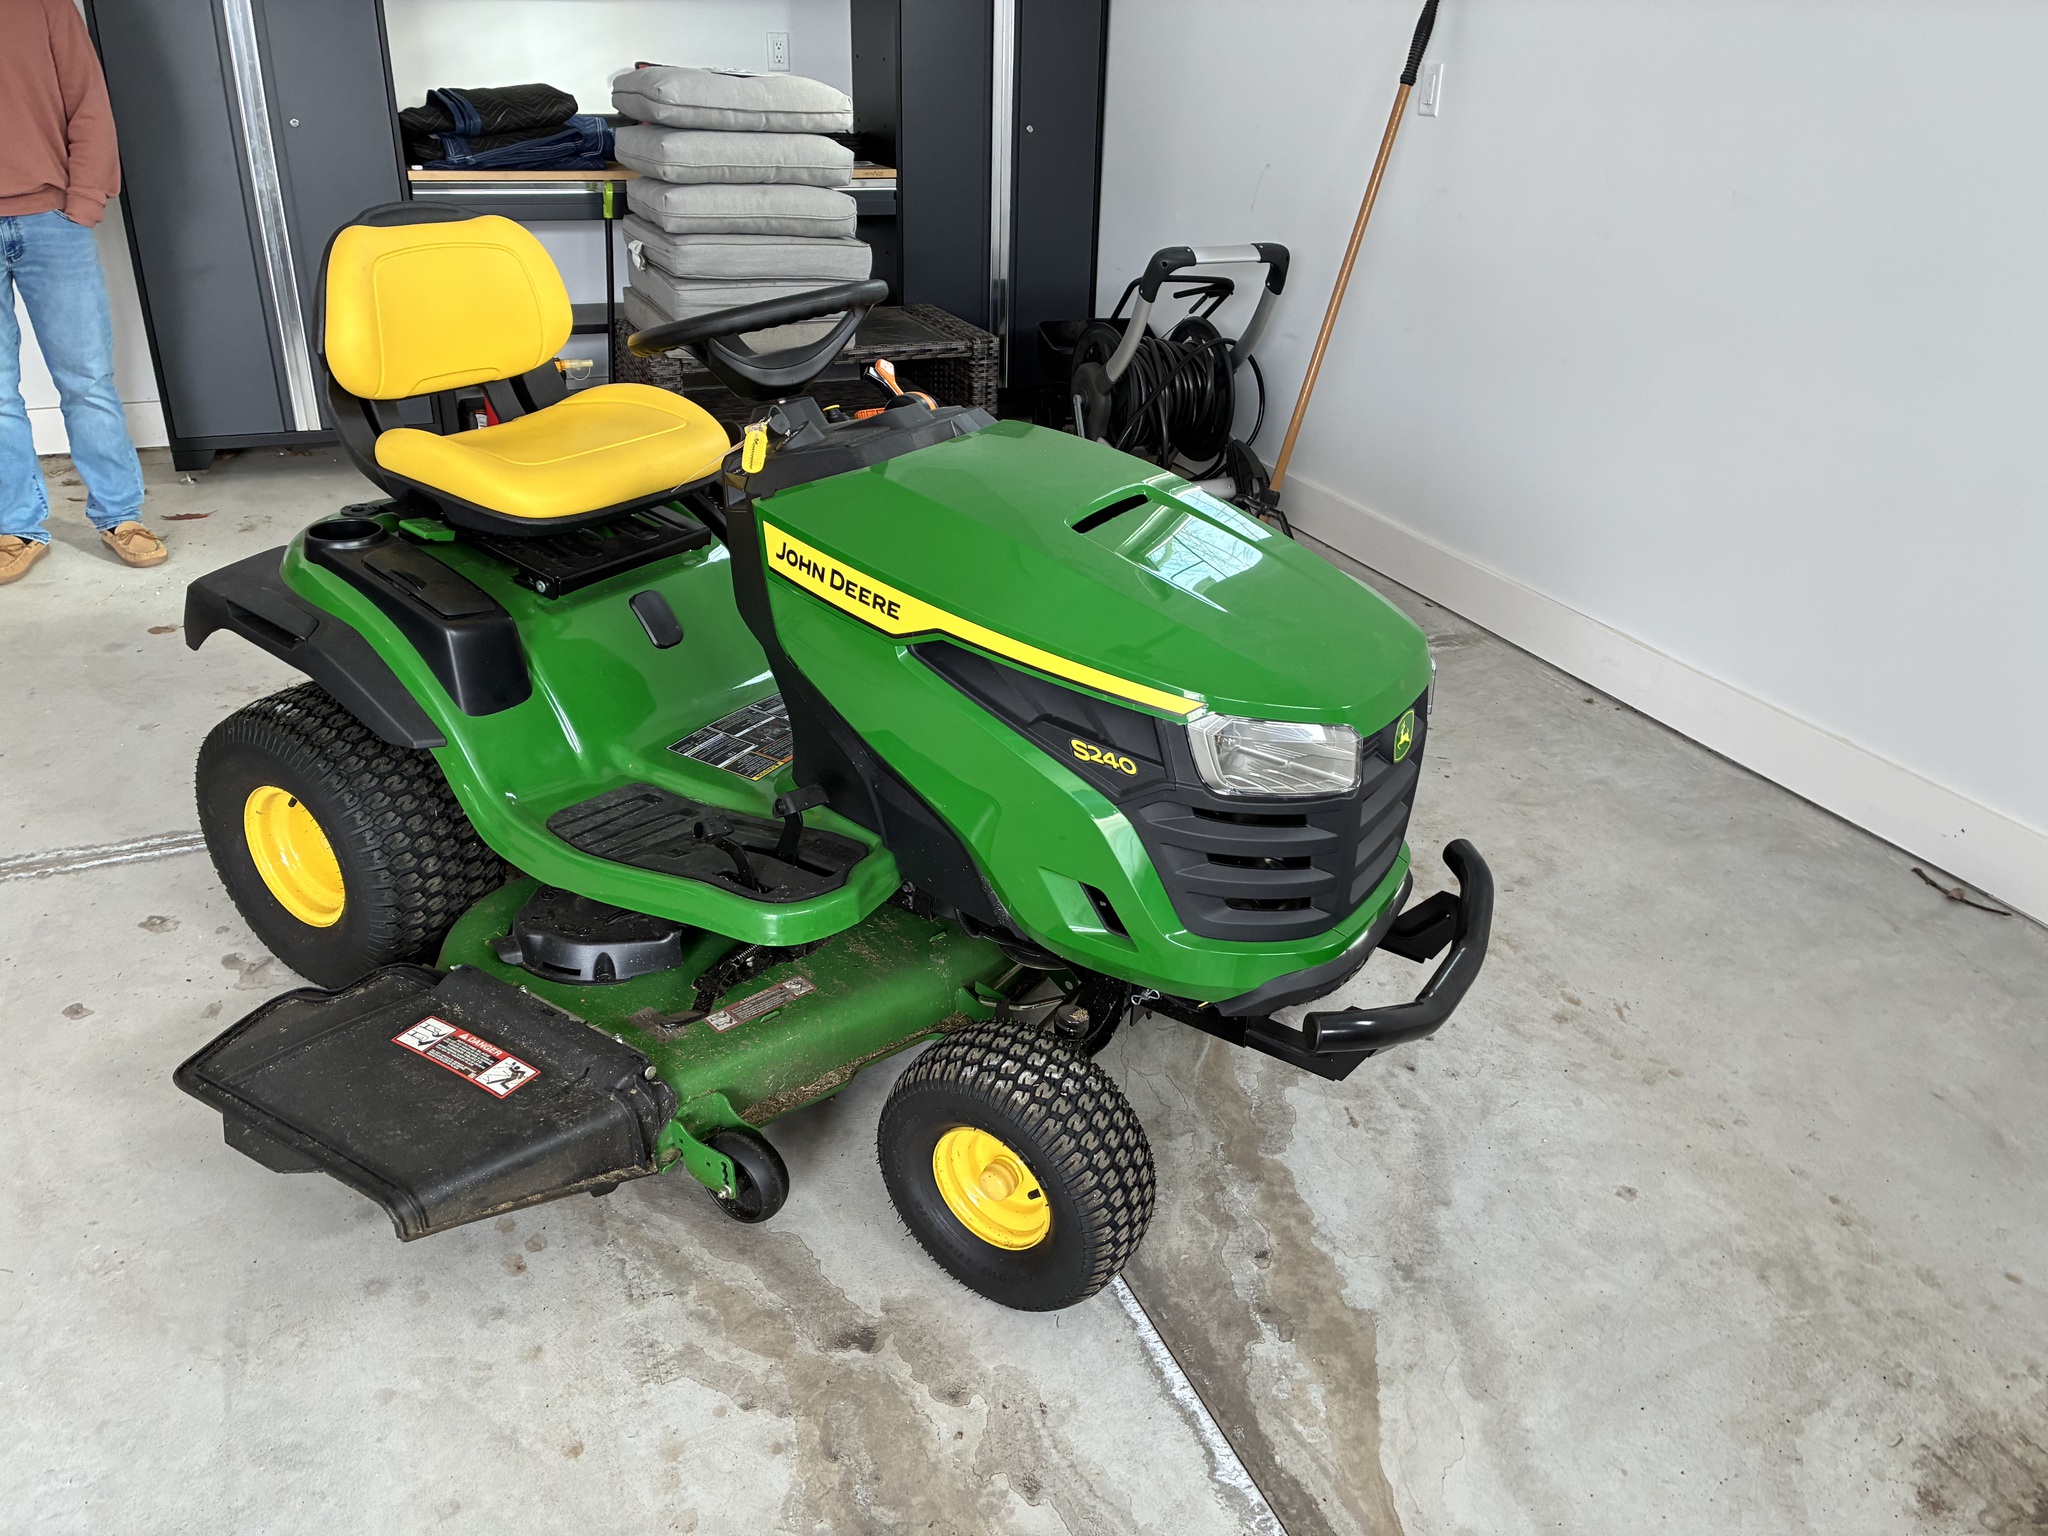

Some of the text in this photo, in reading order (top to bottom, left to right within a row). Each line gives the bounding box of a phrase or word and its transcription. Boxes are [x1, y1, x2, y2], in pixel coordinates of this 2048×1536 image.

[776, 542, 901, 620] JOHN DEERE
[1070, 739, 1137, 775] S240
[467, 1036, 503, 1057] DANGER
